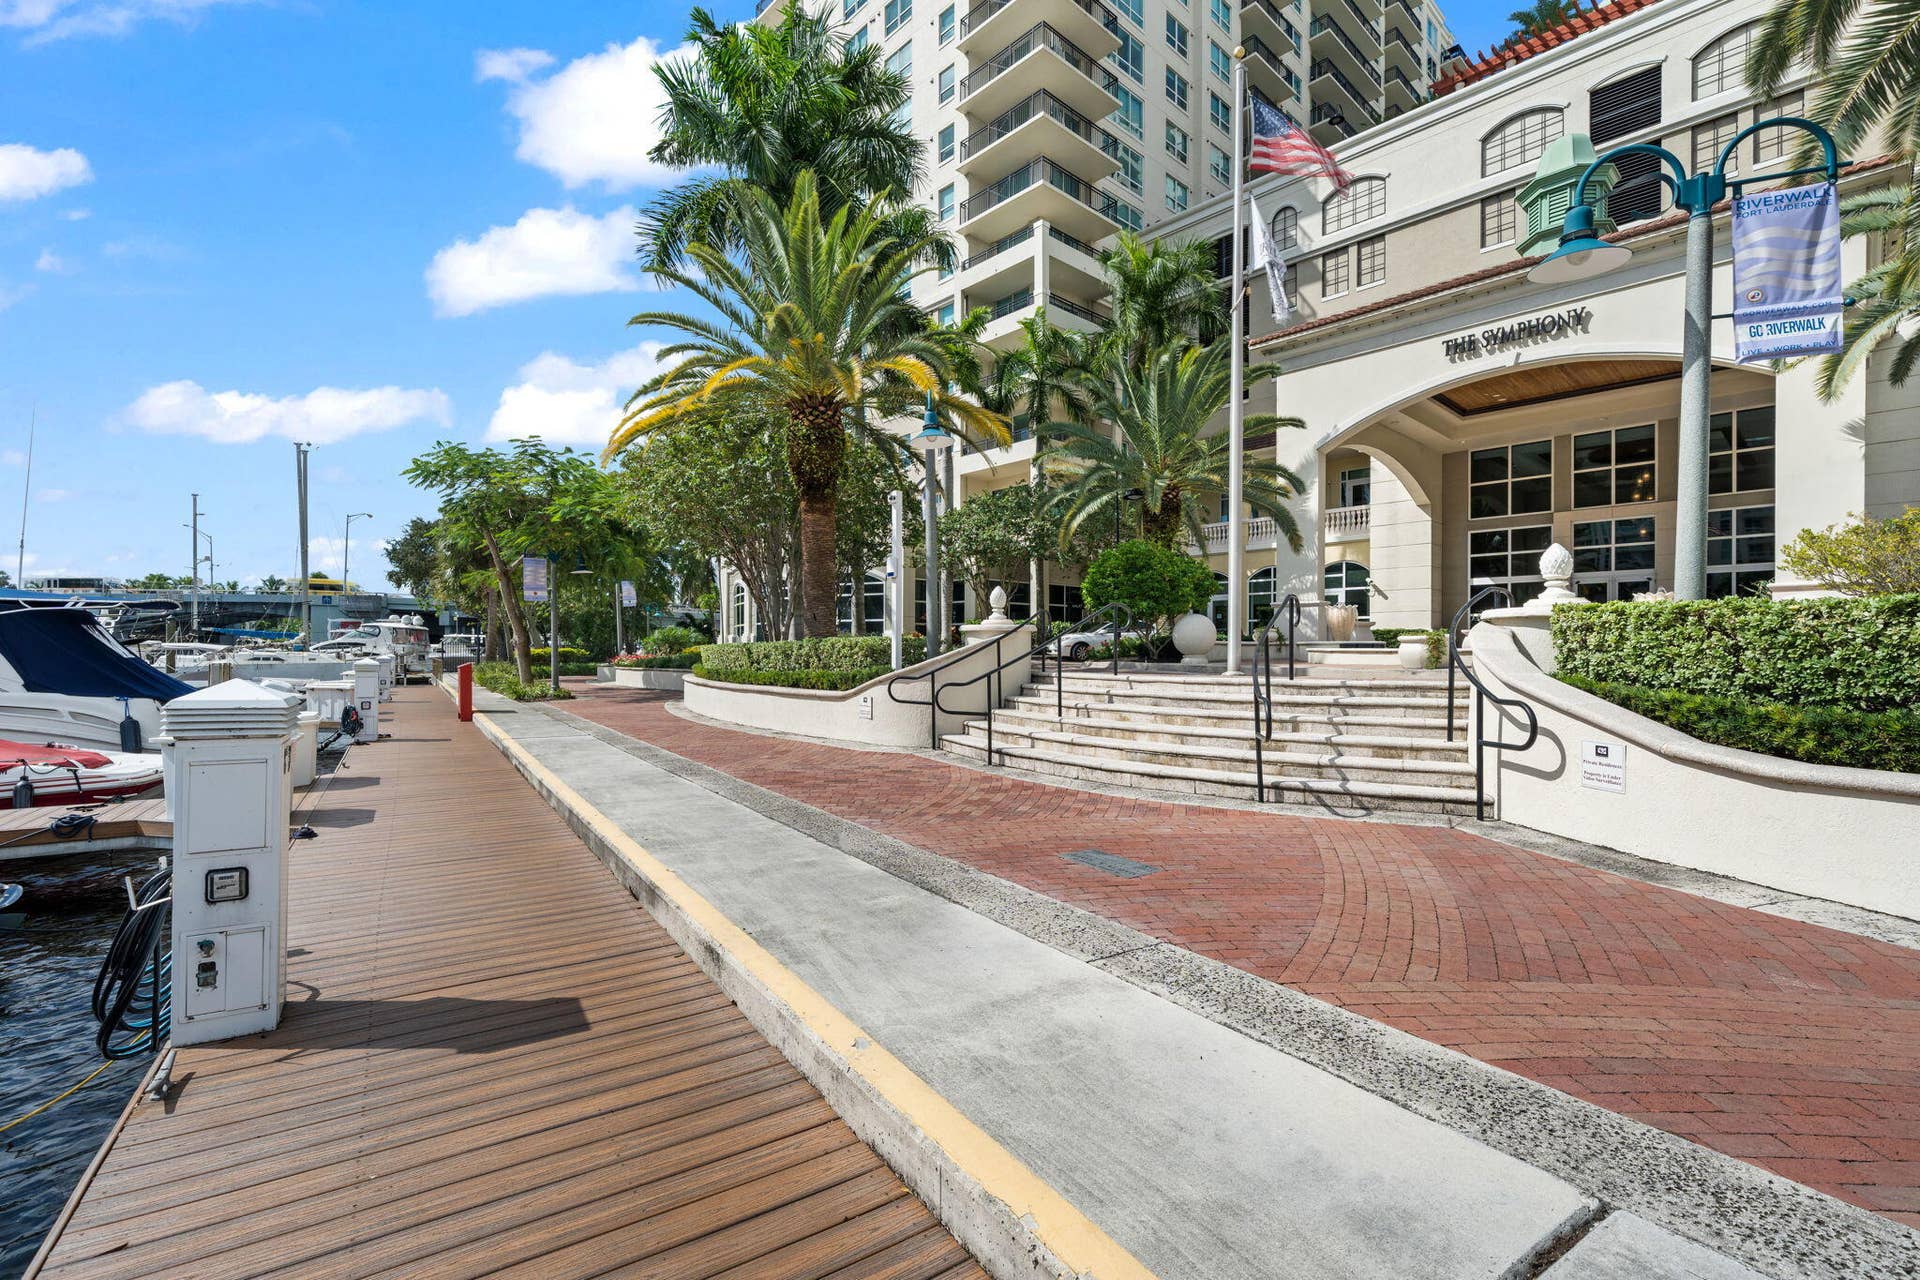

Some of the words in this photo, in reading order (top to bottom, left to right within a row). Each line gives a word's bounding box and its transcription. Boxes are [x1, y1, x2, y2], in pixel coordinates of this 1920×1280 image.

[1735, 208, 1763, 220] FORT
[1766, 199, 1832, 214] LAUDERDALE
[1736, 187, 1833, 212] RIVERWALK
[1442, 334, 1476, 357] THE
[1481, 306, 1587, 348] SYMPHONY
[1766, 317, 1826, 336] RIVERWALK
[1773, 343, 1802, 353] WORK
[1813, 339, 1837, 348] PLAY
